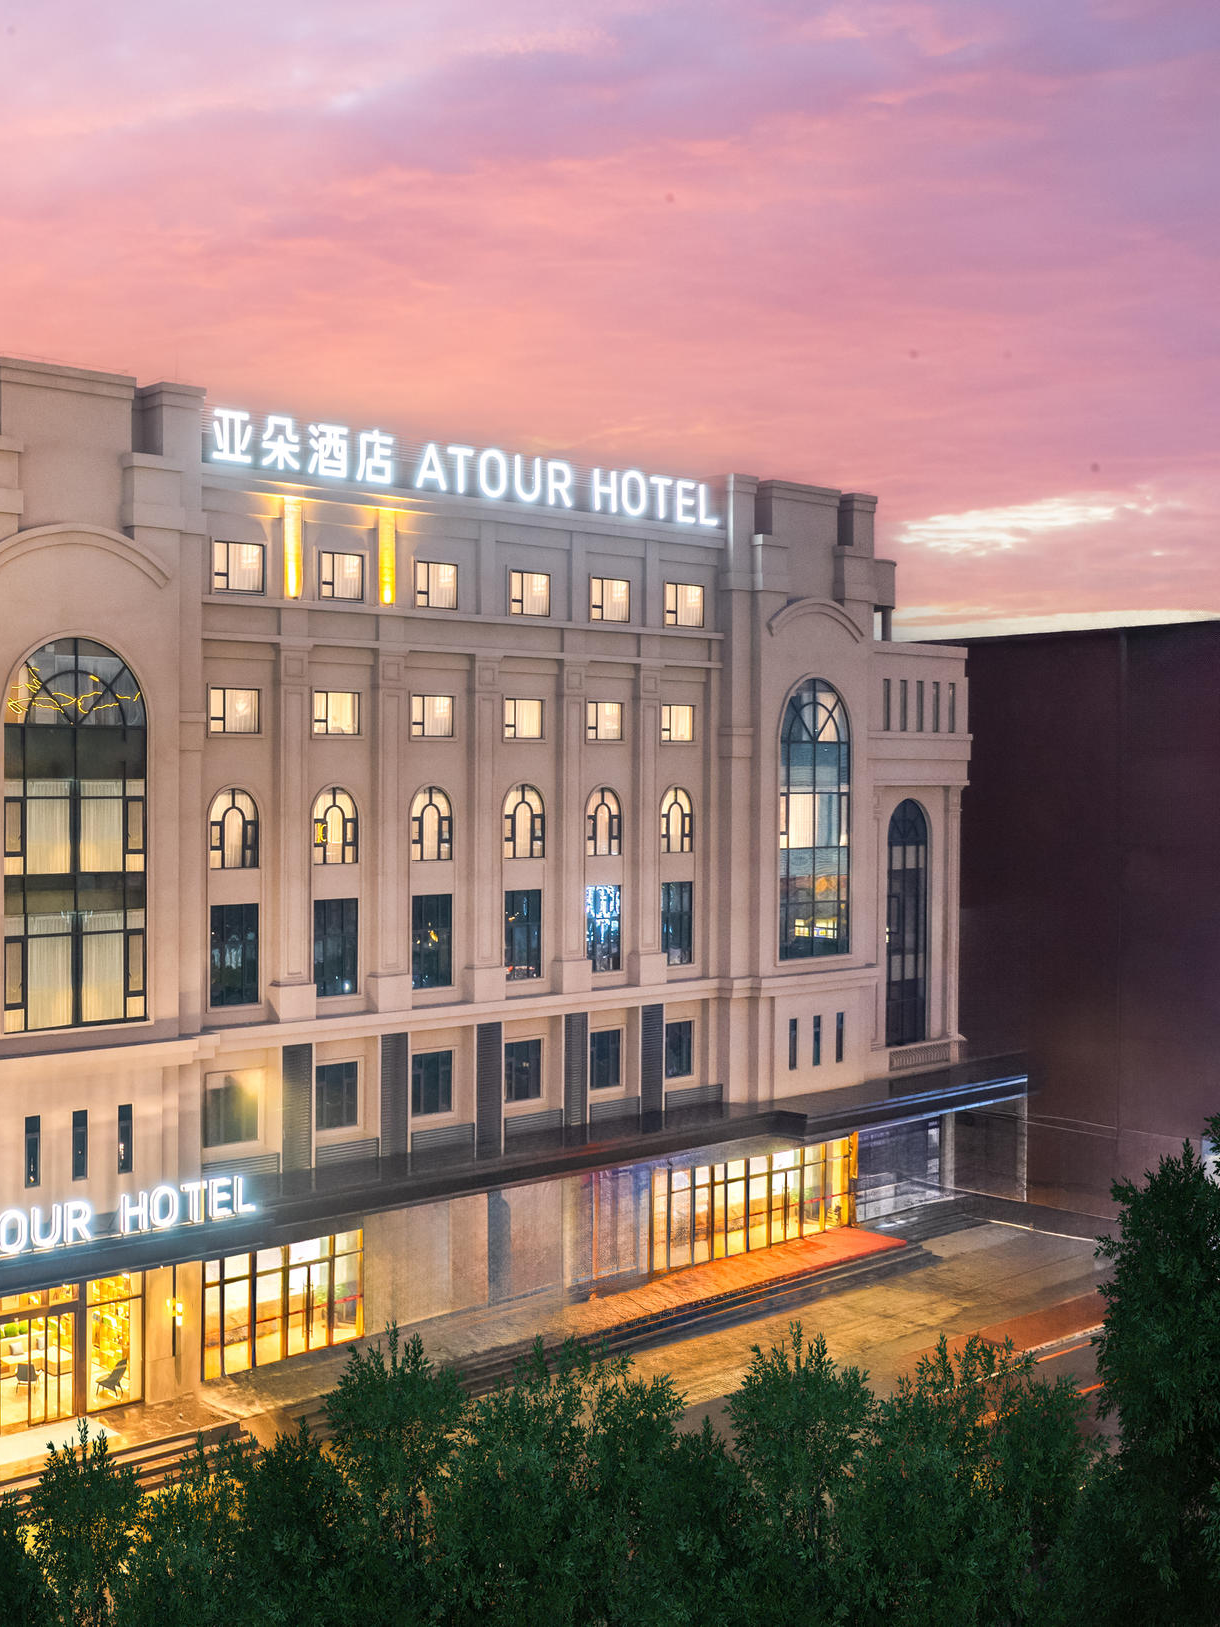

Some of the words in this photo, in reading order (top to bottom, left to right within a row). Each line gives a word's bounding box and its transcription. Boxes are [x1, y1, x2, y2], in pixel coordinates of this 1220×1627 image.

[212, 408, 394, 485] 亚朵酒店
[416, 443, 573, 508] ATOUR
[593, 468, 719, 526] HOTEL
[119, 1175, 256, 1235] HOTEL
